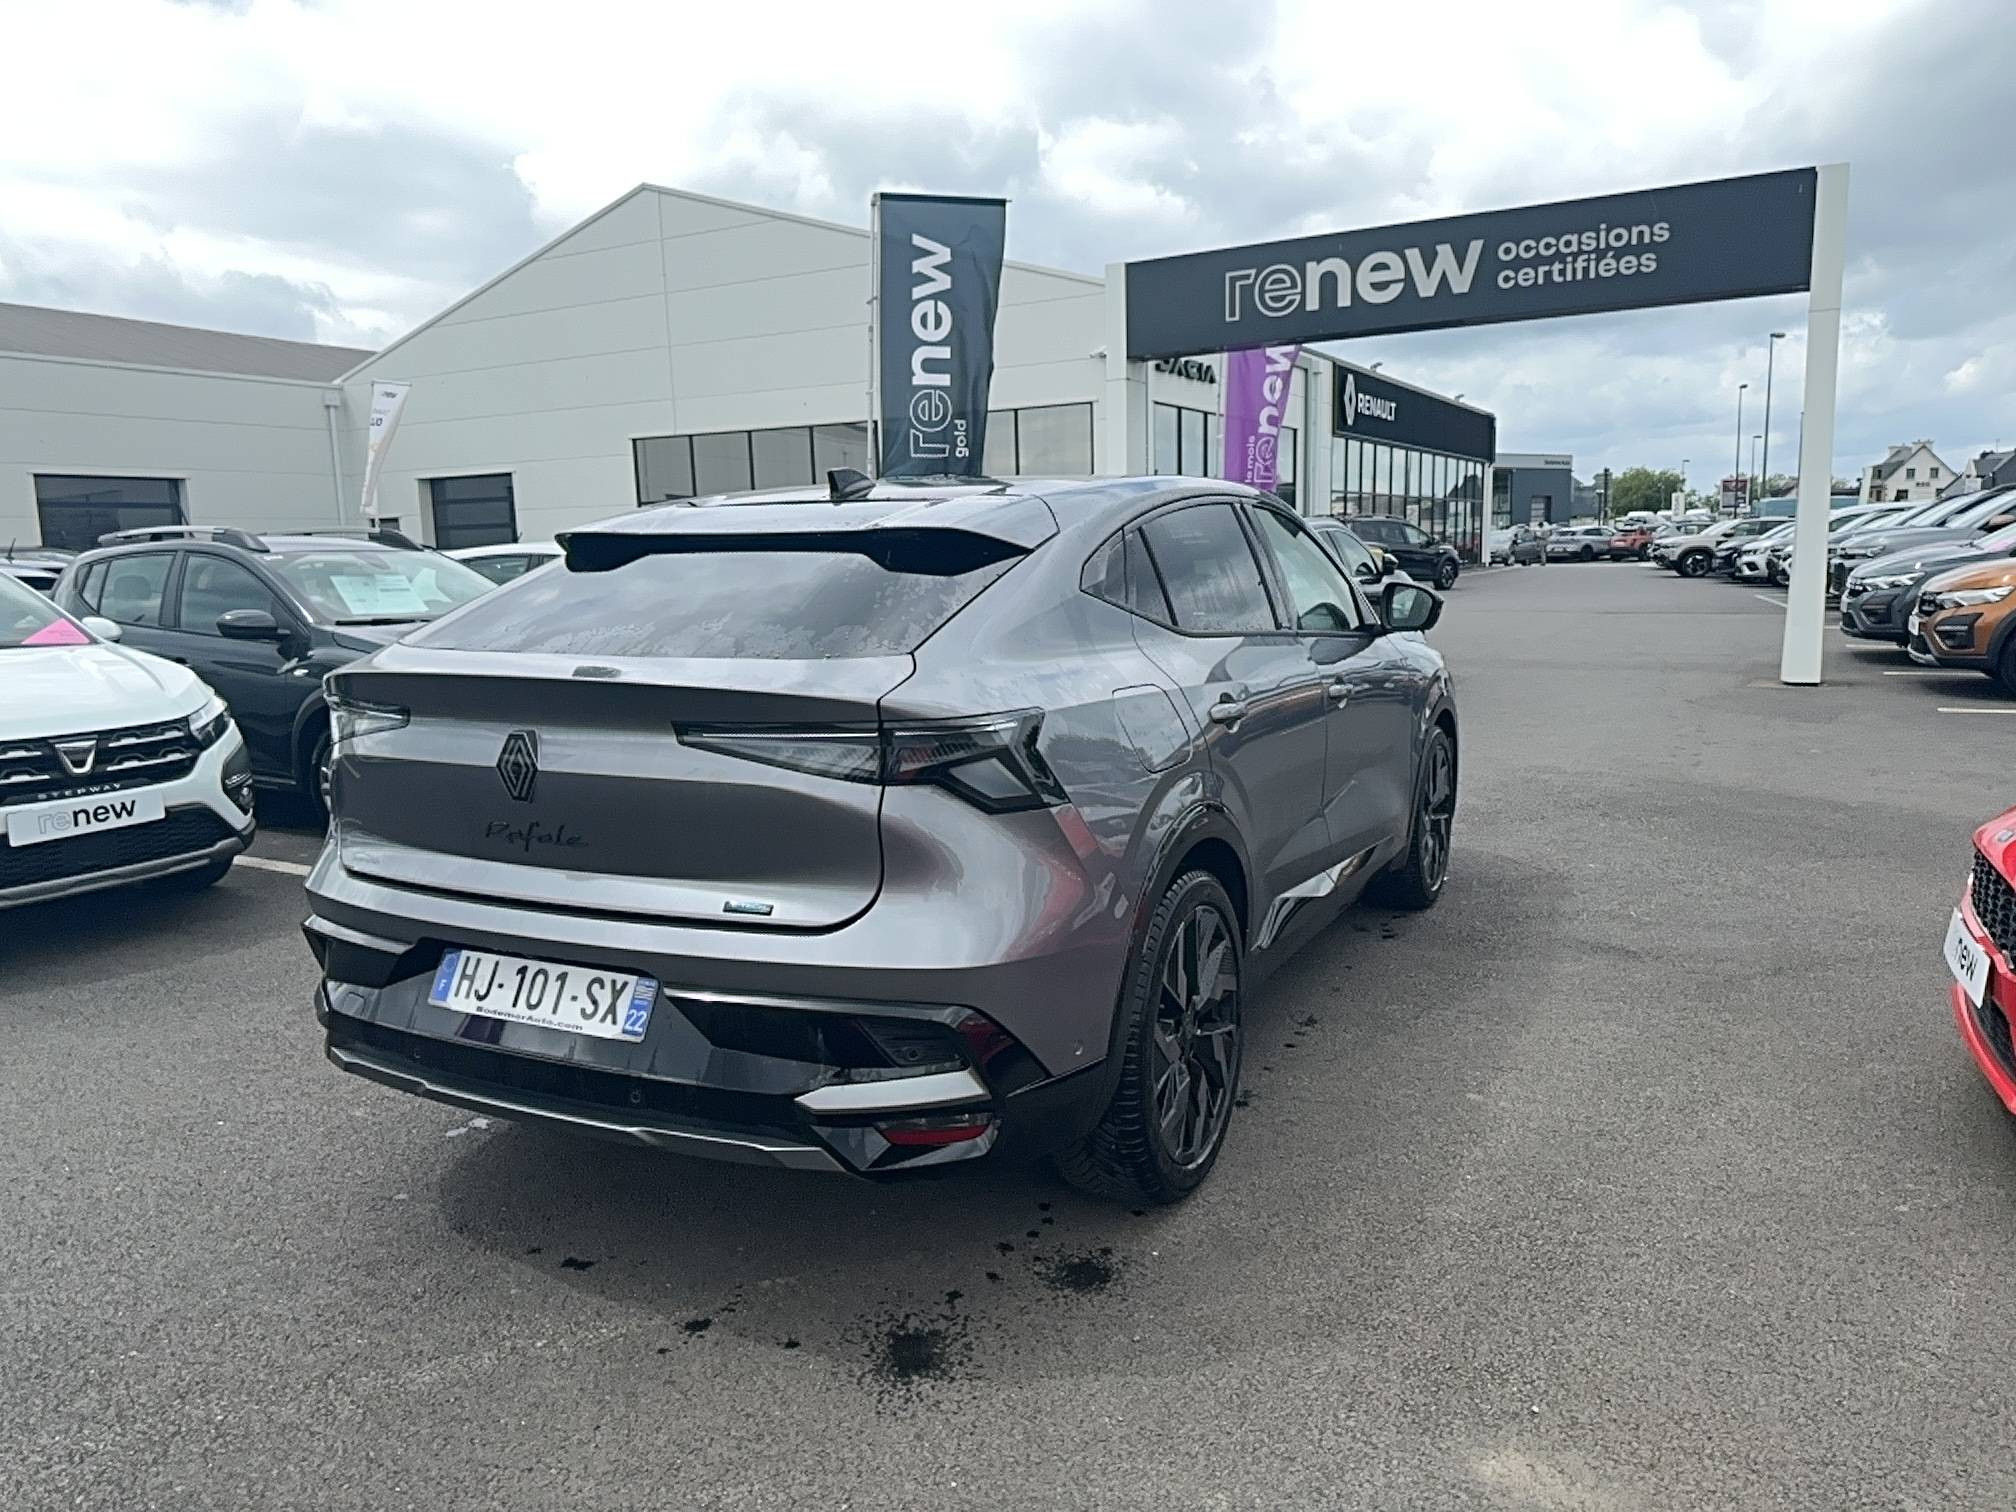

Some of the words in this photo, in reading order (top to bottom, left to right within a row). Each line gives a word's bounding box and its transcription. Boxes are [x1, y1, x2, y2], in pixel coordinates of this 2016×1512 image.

[1497, 221, 1671, 262] occasions
[1224, 238, 1485, 323] renew
[1496, 250, 1658, 290] certifiées
[909, 232, 953, 459] renew
[1356, 392, 1398, 422] RENAULT
[953, 418, 969, 458] gold
[37, 799, 136, 835] renew
[484, 820, 590, 853] Rafale
[437, 979, 447, 992] F
[453, 955, 630, 1026] HJ-101-SX
[624, 1008, 648, 1033] 22
